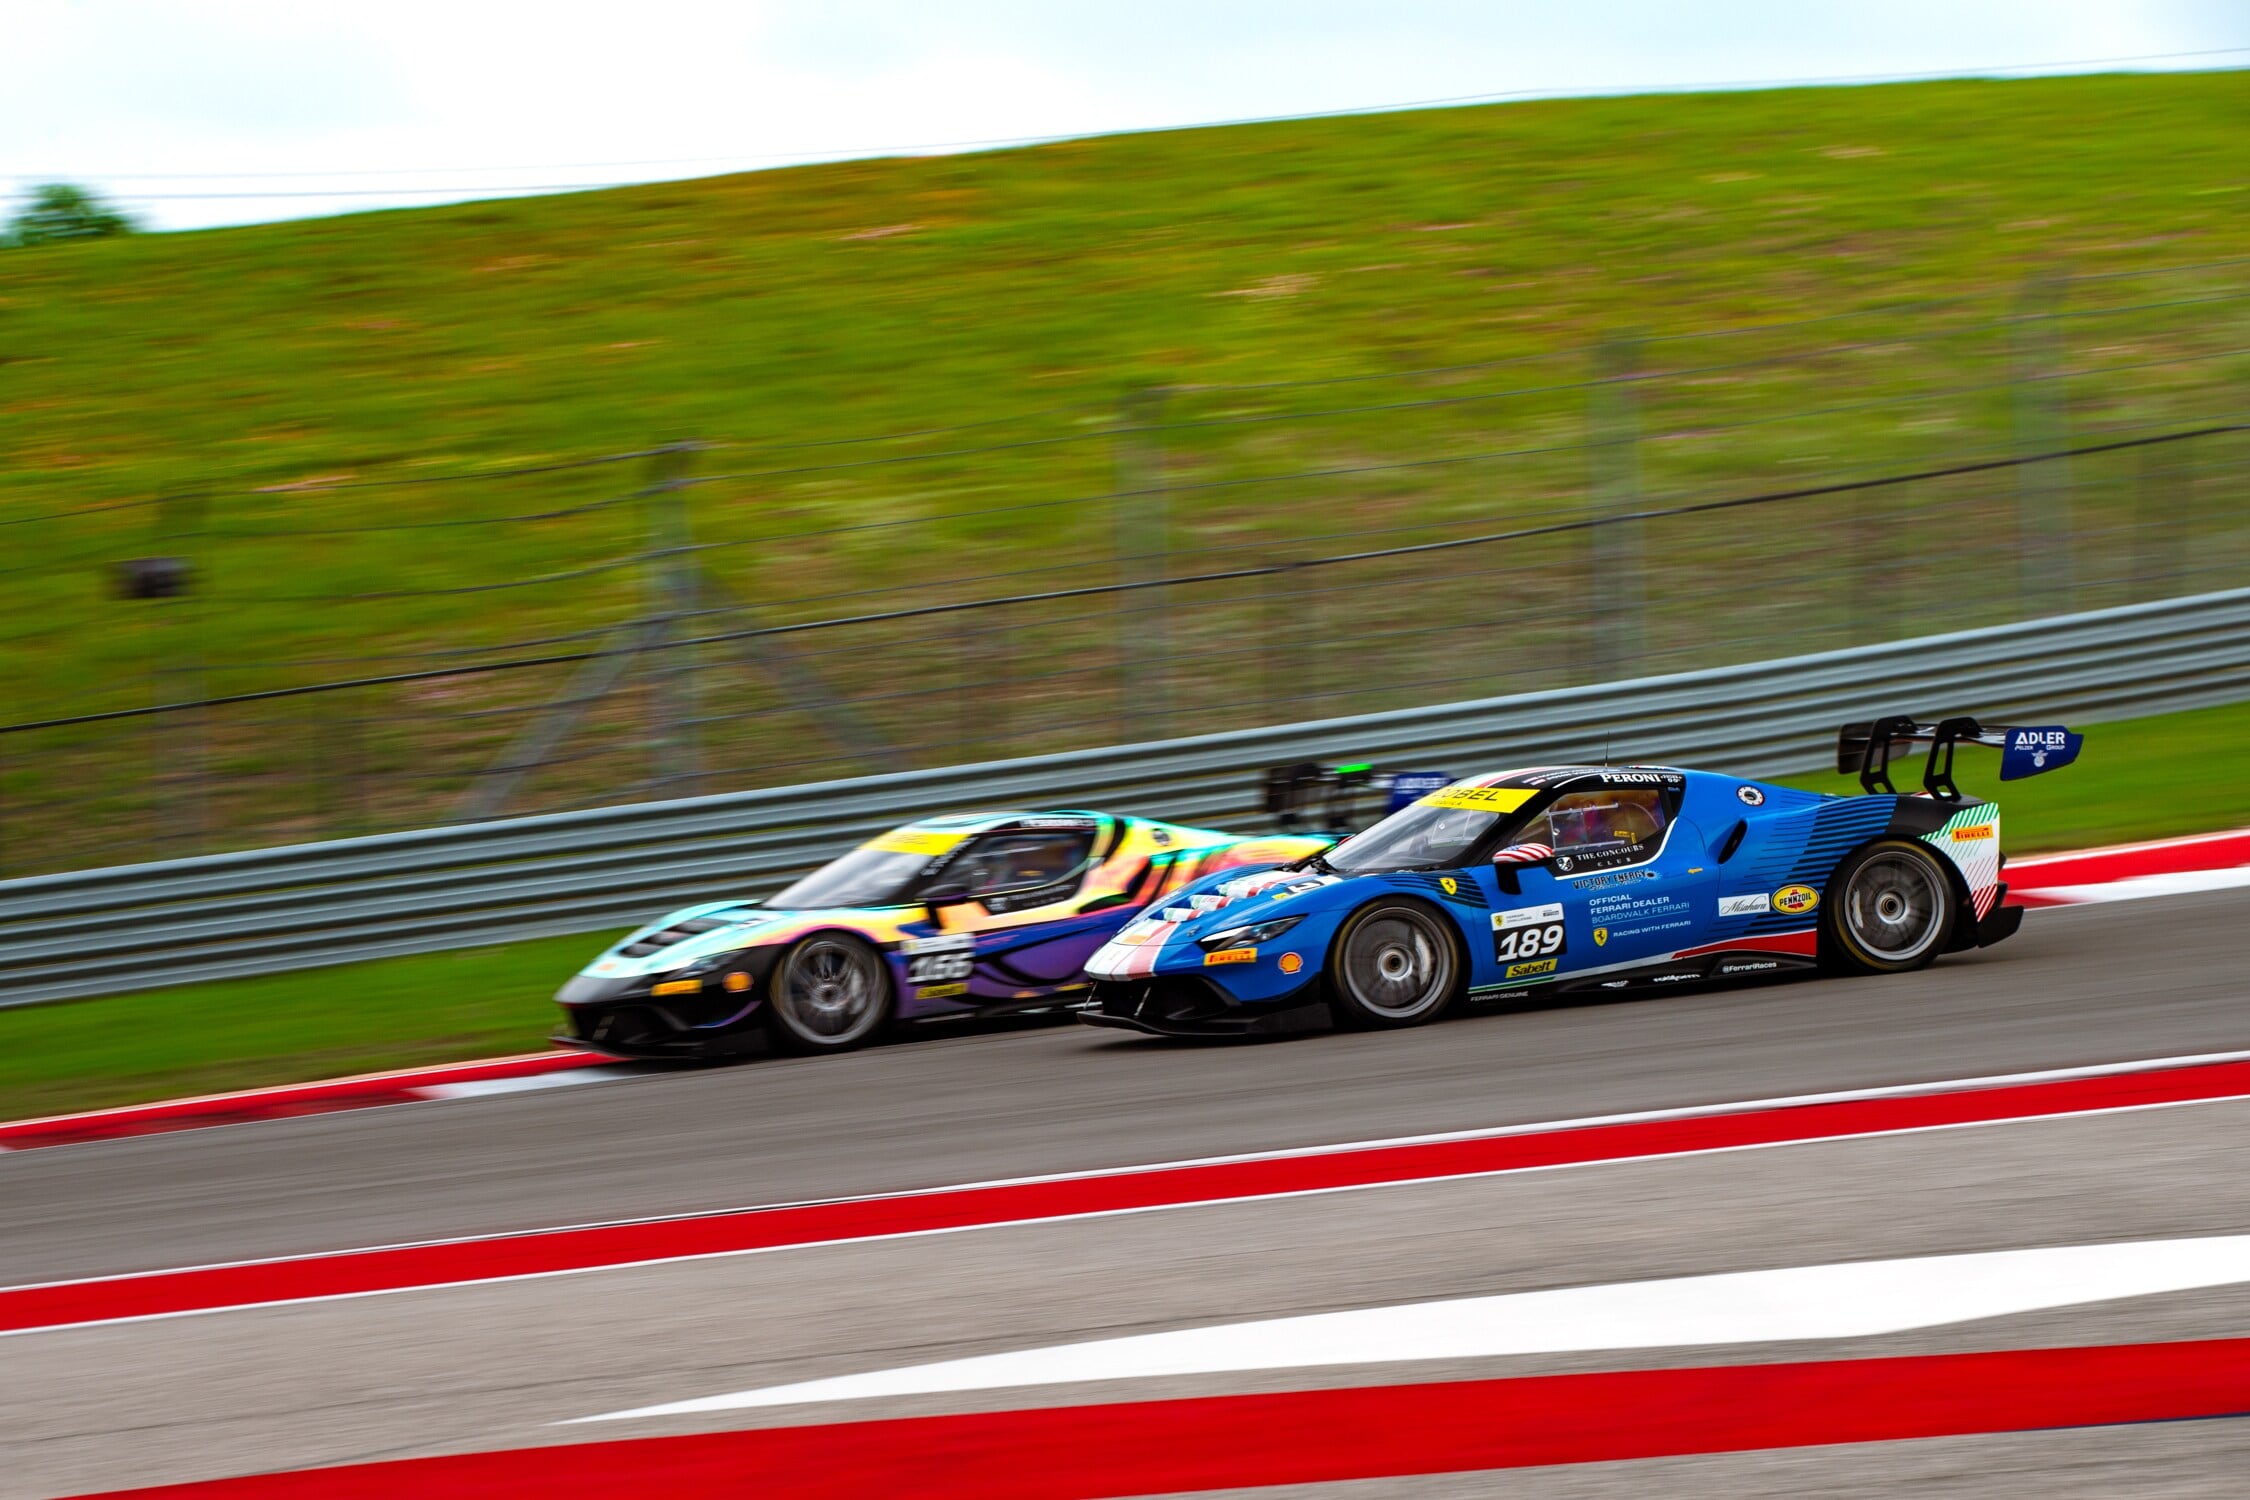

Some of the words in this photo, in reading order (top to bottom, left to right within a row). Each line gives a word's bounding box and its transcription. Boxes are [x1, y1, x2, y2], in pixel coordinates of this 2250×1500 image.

[2014, 731, 2065, 745] ADLER
[1600, 773, 1662, 783] PERONI
[1955, 827, 1991, 840] PIRELLI
[1575, 851, 1596, 861] THE
[1596, 844, 1645, 858] CONCOURS
[1597, 856, 1632, 867] CLUB
[1572, 875, 1612, 889] VICTORY
[1613, 869, 1646, 883] ENERGY
[1589, 894, 1633, 906] OFFICIAL
[1590, 903, 1631, 915] FERRARI
[1632, 896, 1670, 908] DEALER
[1779, 892, 1812, 906] PENNZOIL
[1591, 908, 1650, 924] BOARDWALK
[1651, 902, 1690, 914] FERRARI
[1613, 928, 1640, 937] RACING
[1641, 925, 1660, 933] WITH
[1661, 920, 1692, 930] FERRARI
[1497, 925, 1565, 962] 189
[1208, 950, 1252, 963] PIRELLI
[1511, 961, 1552, 976] Sabelt
[1722, 962, 1777, 973] @FerrariRaces
[1470, 994, 1499, 1002] FERRARI
[1500, 991, 1529, 999] GENUINE
